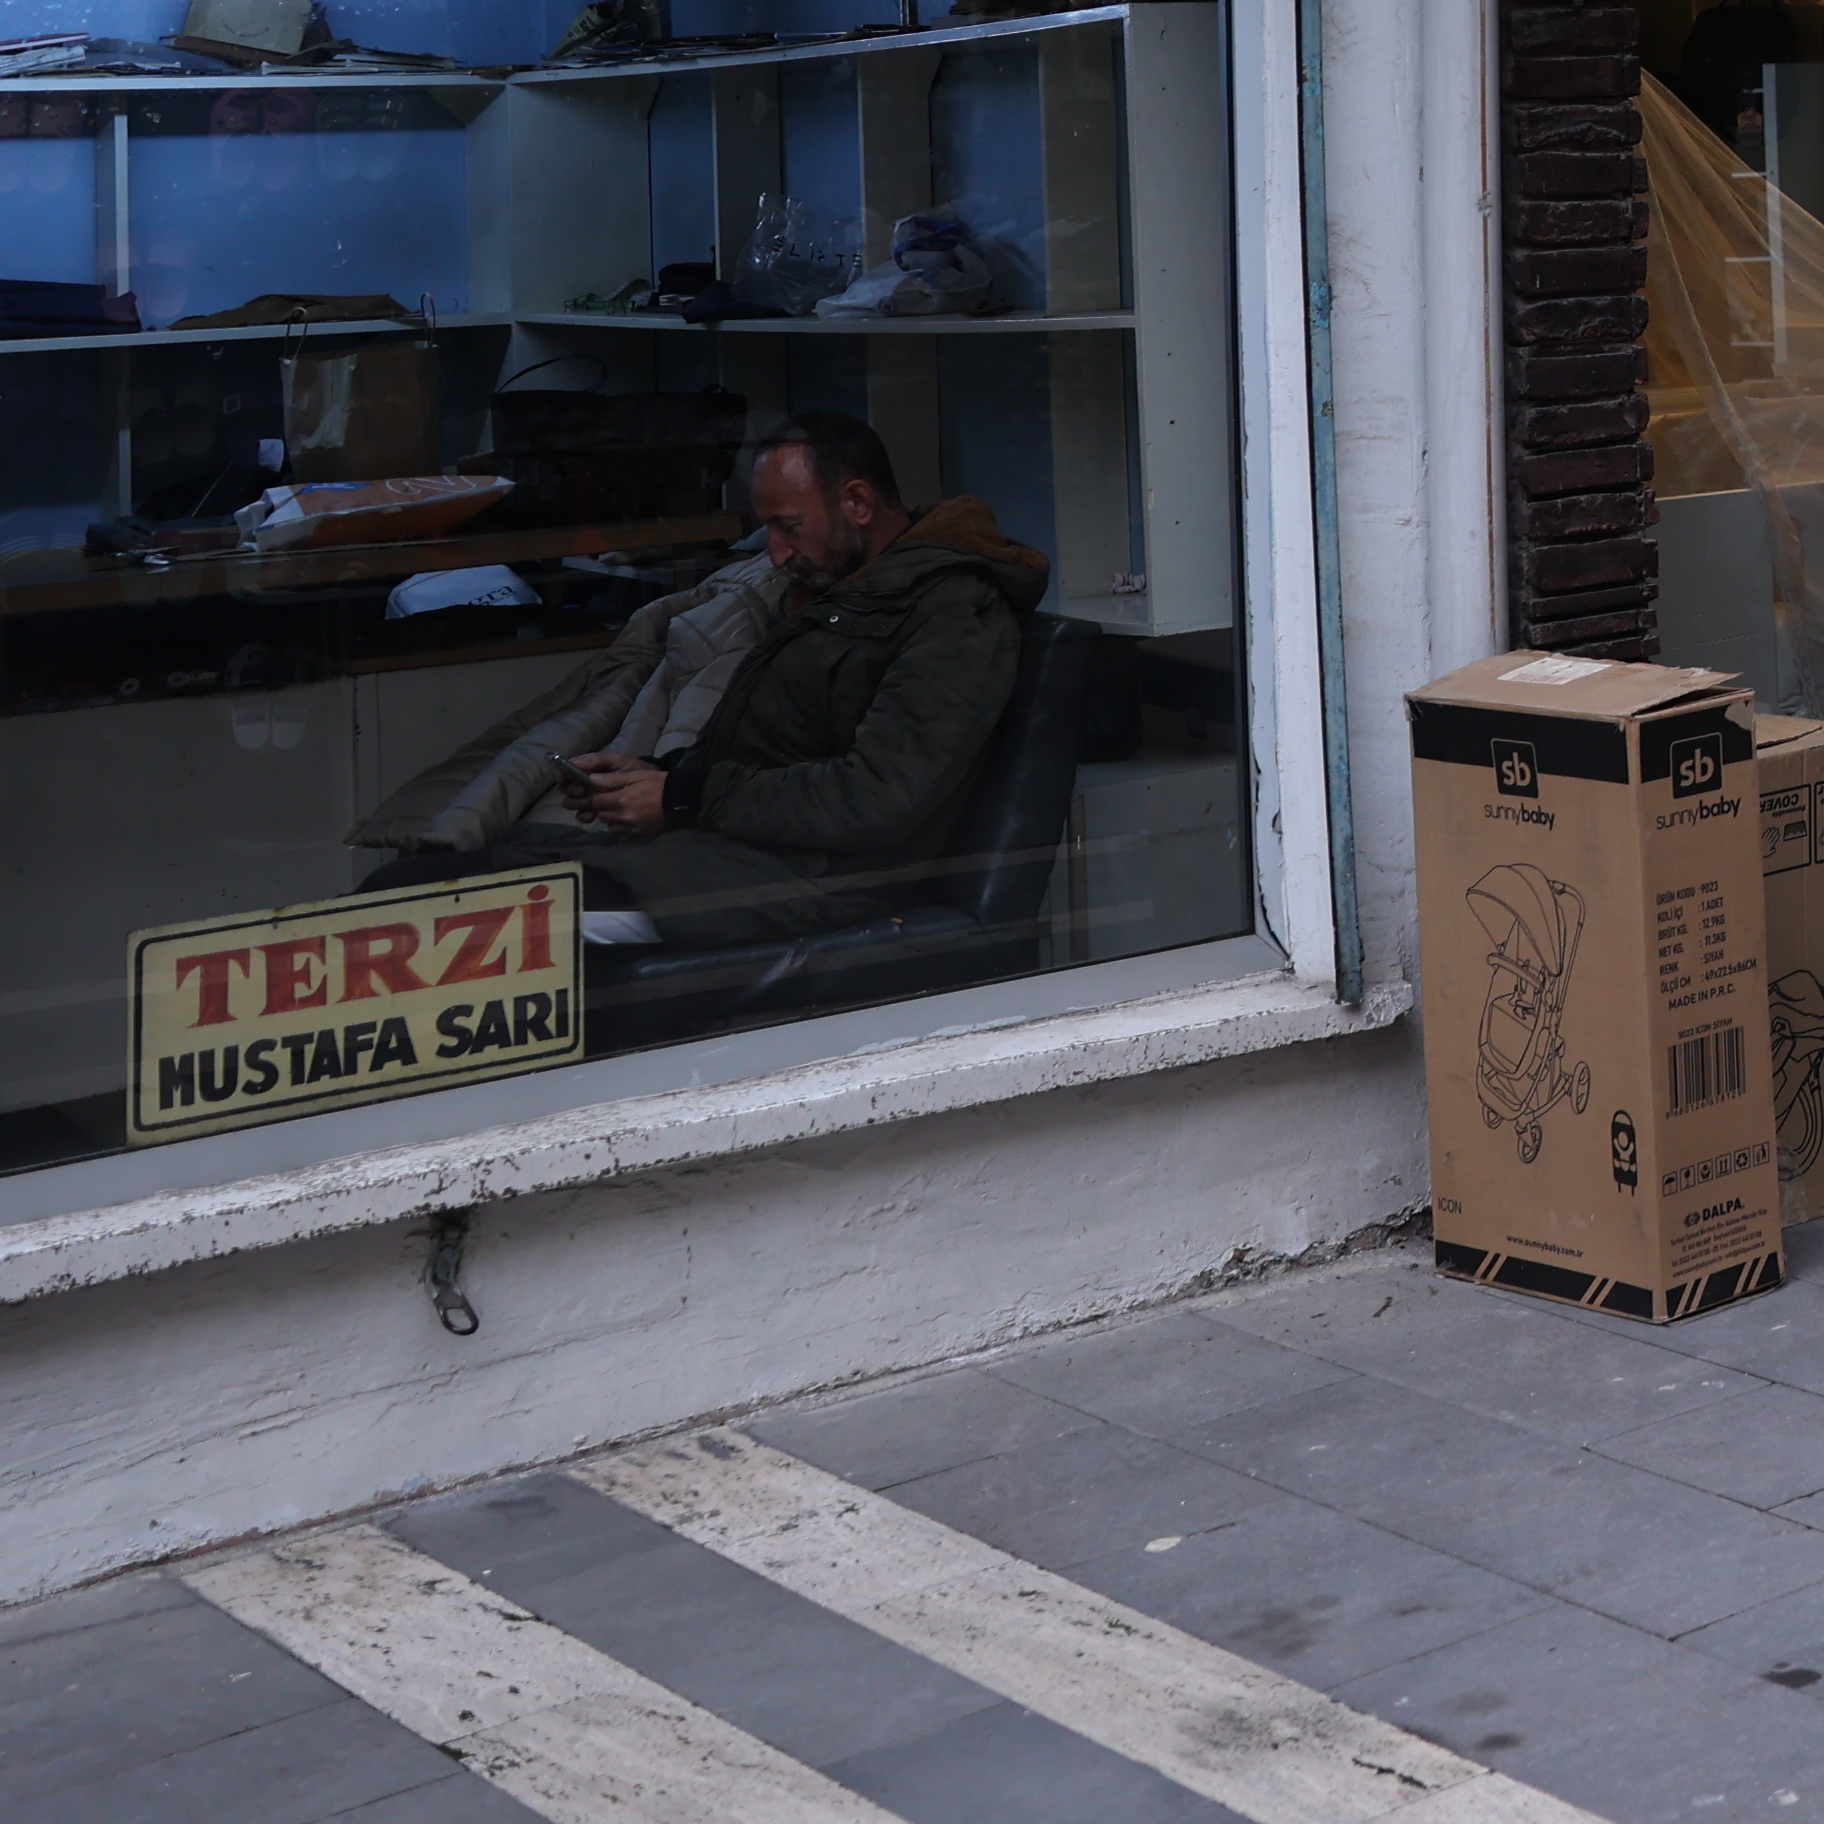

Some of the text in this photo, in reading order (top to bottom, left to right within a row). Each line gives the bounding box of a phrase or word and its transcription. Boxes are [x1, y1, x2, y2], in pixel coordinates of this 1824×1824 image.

[1501, 752, 1531, 787] sb
[1679, 747, 1714, 787] sb
[1484, 802, 1555, 831] sunnybaby
[1656, 795, 1741, 830] sunnybaby
[175, 883, 557, 1029] TERZİ
[1659, 961, 1679, 976] RENK
[1668, 983, 1737, 1010] MADE IN P.R.C.
[158, 988, 570, 1110] MUSTAFA SARI
[1438, 1197, 1462, 1215] ICON
[1702, 1197, 1743, 1222] DALPA
